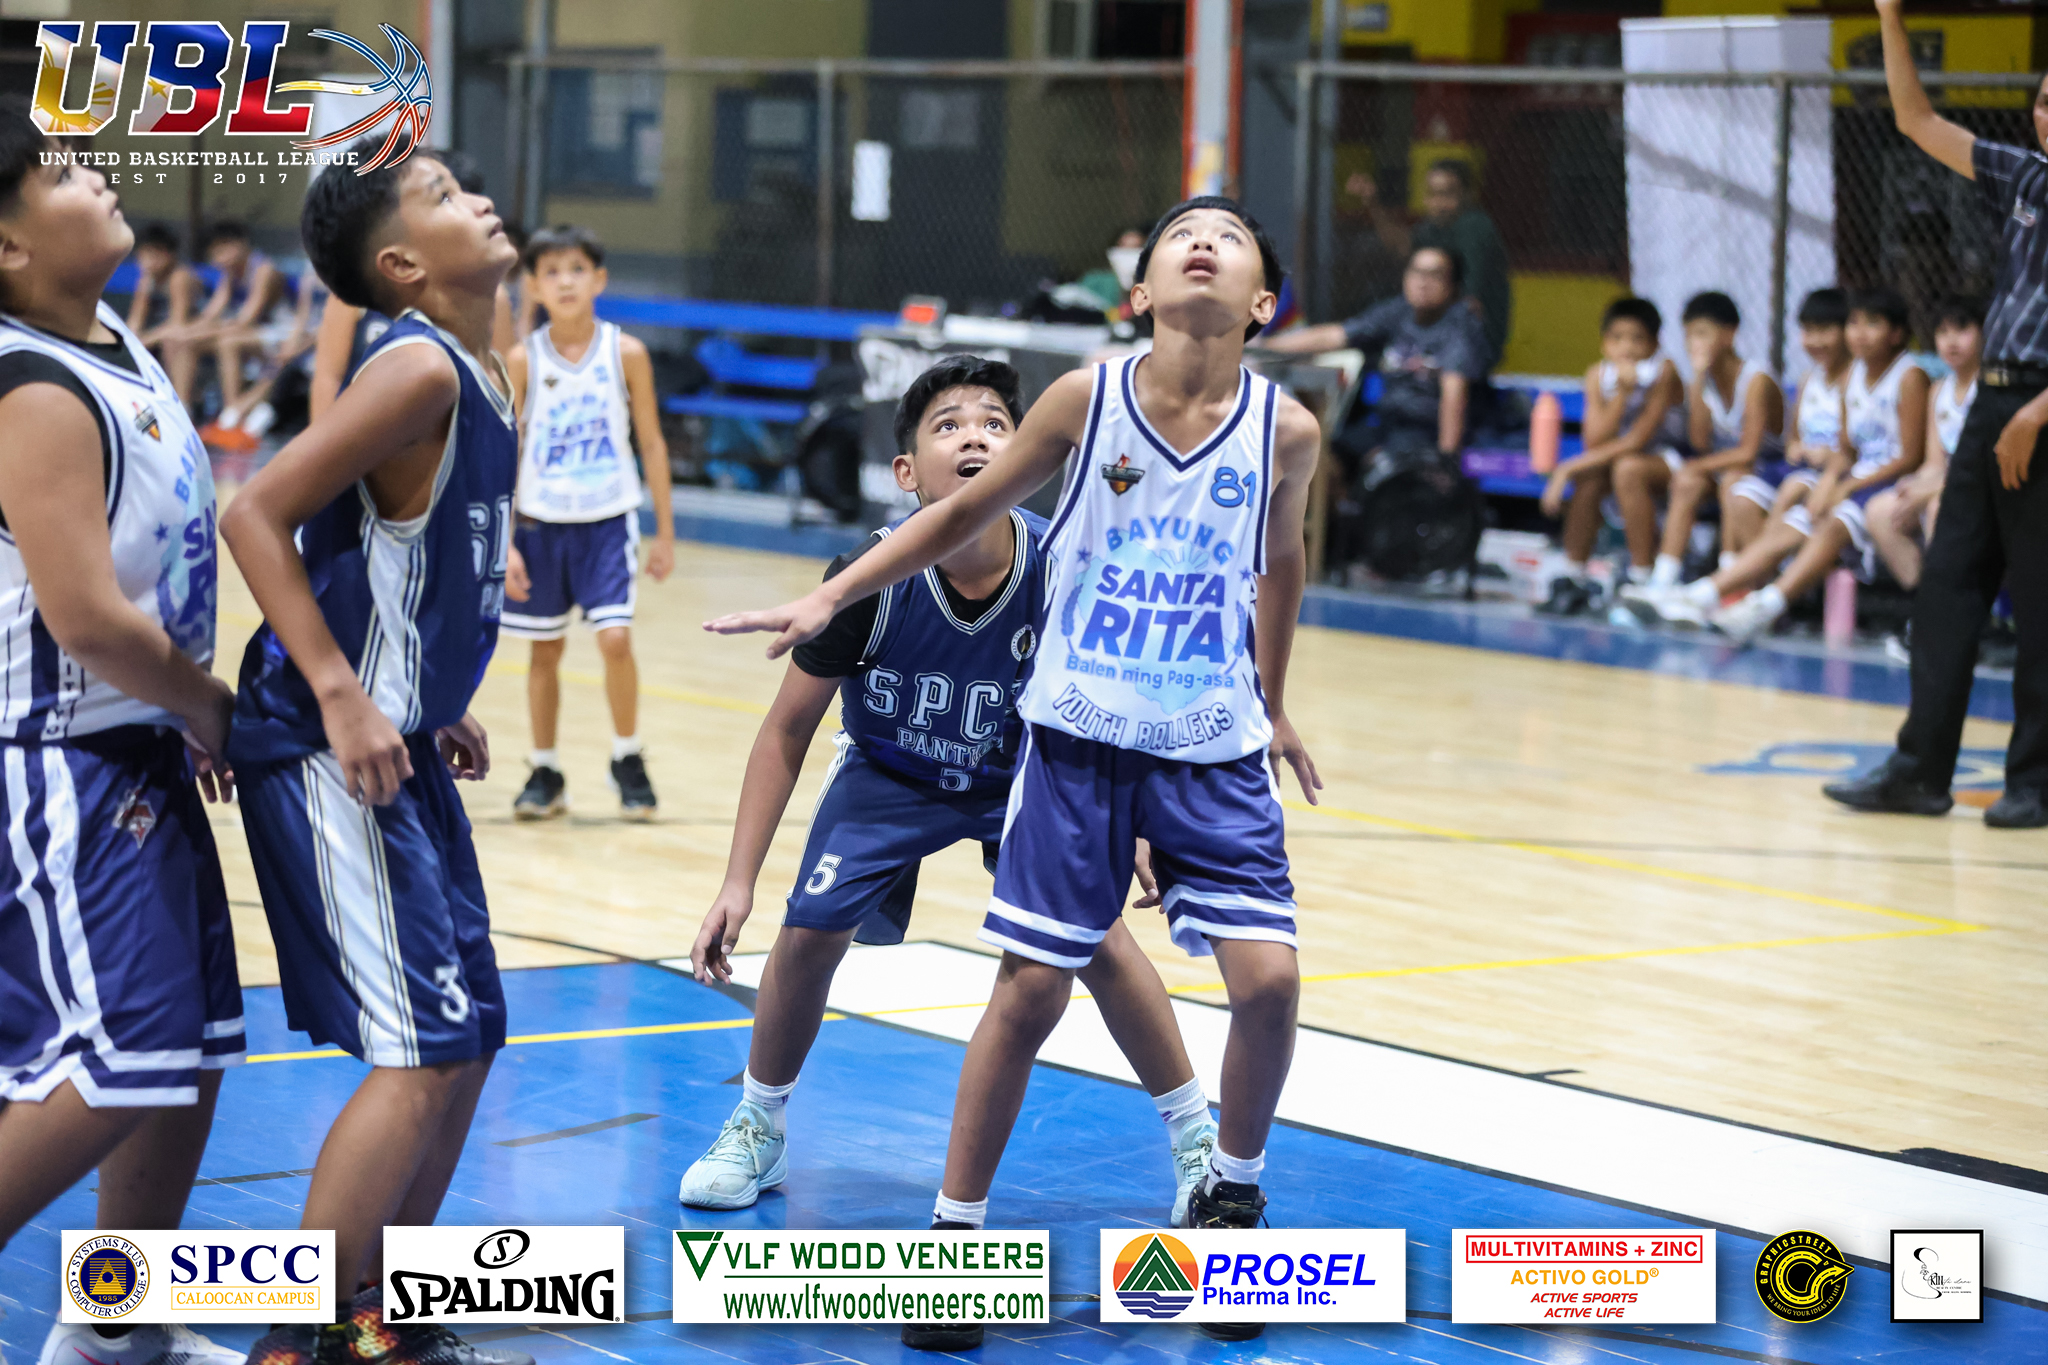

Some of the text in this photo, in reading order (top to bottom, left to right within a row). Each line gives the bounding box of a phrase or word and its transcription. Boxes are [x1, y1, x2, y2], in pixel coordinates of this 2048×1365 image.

[1210, 466, 1256, 508] 81
[1105, 515, 1234, 566] BAYUNG
[1096, 564, 1226, 608] SANTA
[1079, 598, 1227, 664] RITA
[1066, 654, 1235, 689] Balen ning Pag-asa
[1052, 682, 1234, 750] YOUTH BALLERS
[939, 767, 973, 792] 5
[804, 852, 843, 896] 5
[434, 963, 469, 1023] 3
